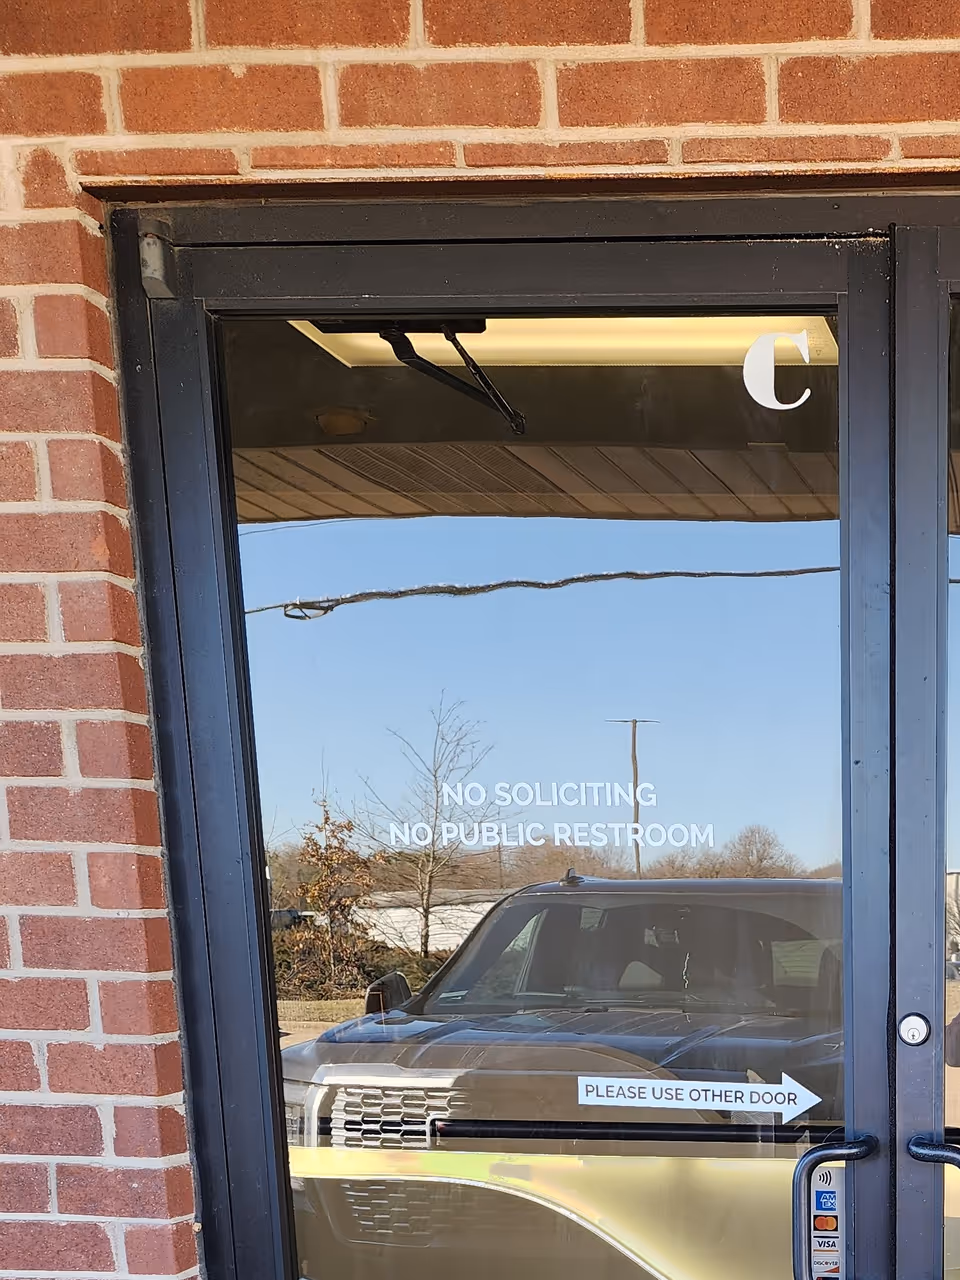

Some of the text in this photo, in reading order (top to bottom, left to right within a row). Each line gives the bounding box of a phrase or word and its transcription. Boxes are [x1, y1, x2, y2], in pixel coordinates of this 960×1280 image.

[743, 329, 811, 410] C
[442, 782, 657, 806] NO SOLICITING
[389, 822, 715, 847] NO PUBLIC RESTROOM
[585, 1084, 797, 1105] PLEASE USE OTHER DOOR
[817, 1240, 837, 1248] VISA
